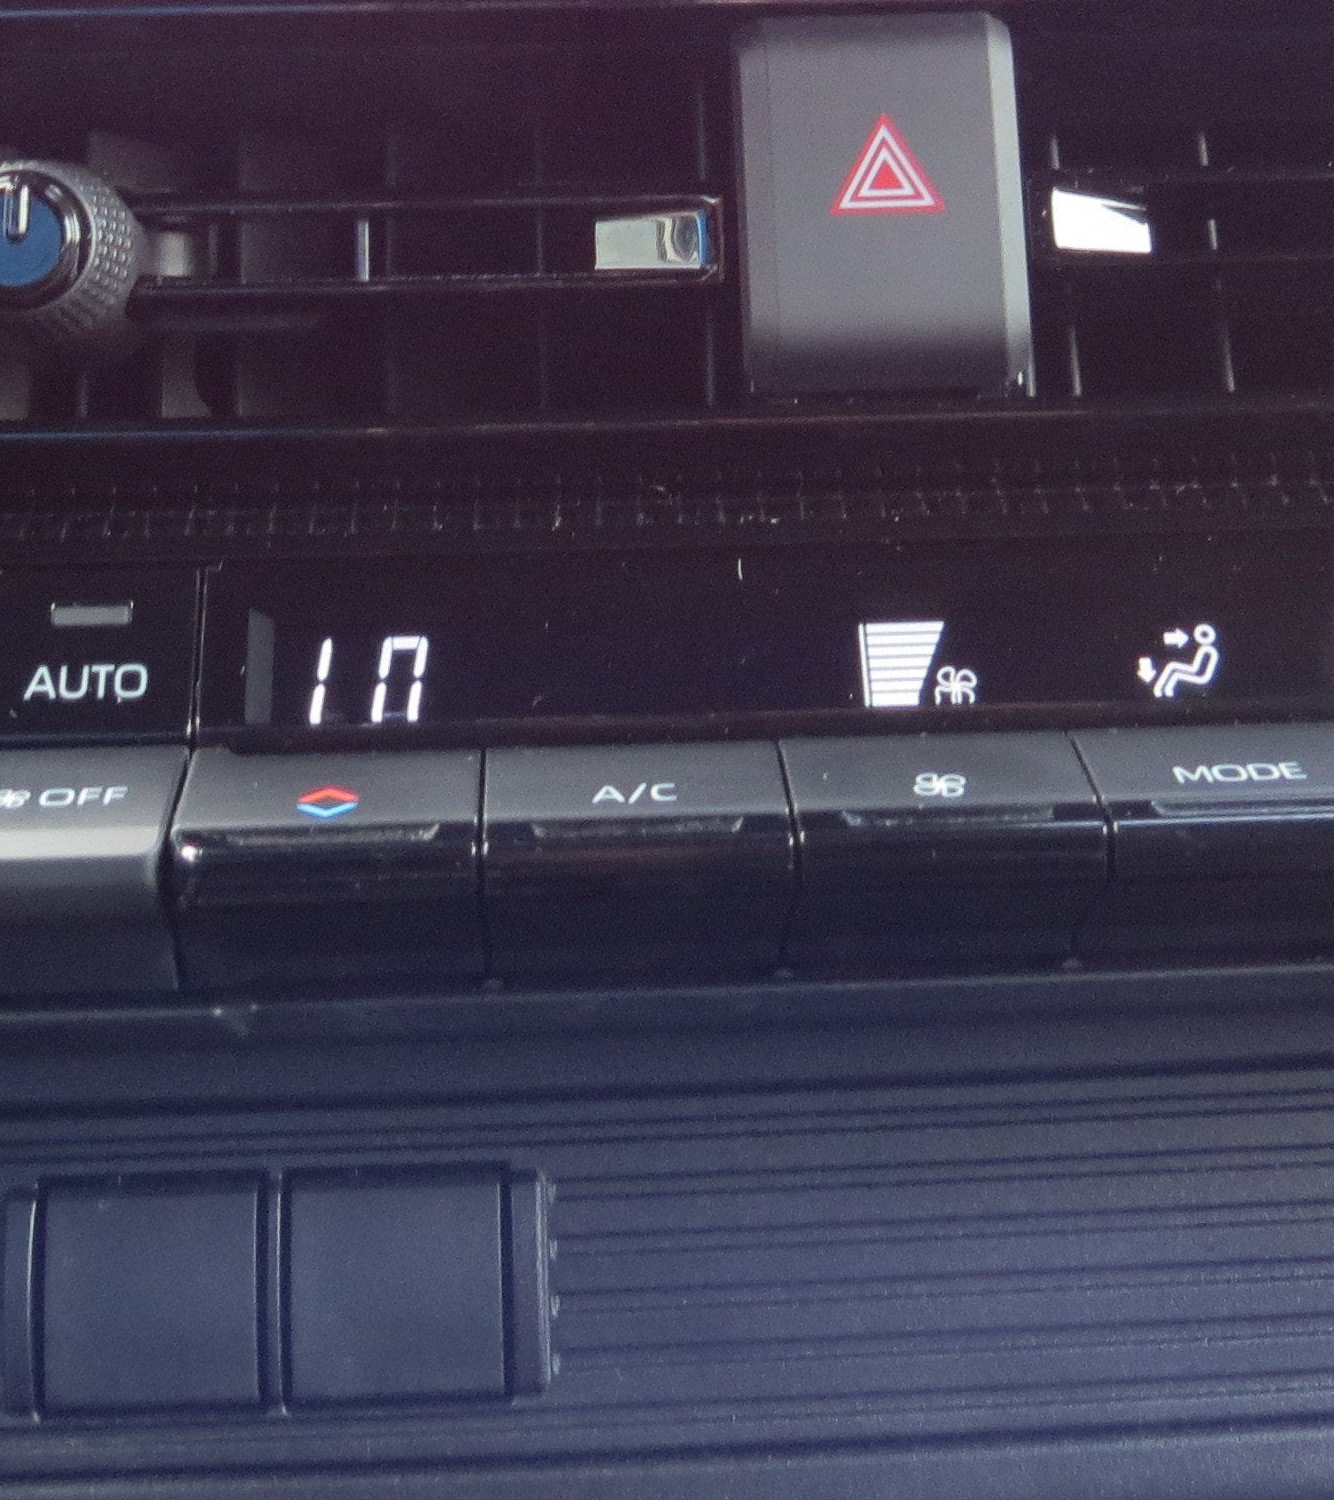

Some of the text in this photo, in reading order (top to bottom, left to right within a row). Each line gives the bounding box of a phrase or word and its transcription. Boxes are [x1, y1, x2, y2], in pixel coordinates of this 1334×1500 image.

[22, 663, 148, 700] AUTO
[1171, 760, 1308, 785] MODE
[38, 786, 129, 810] OFF
[591, 781, 679, 805] A/C
